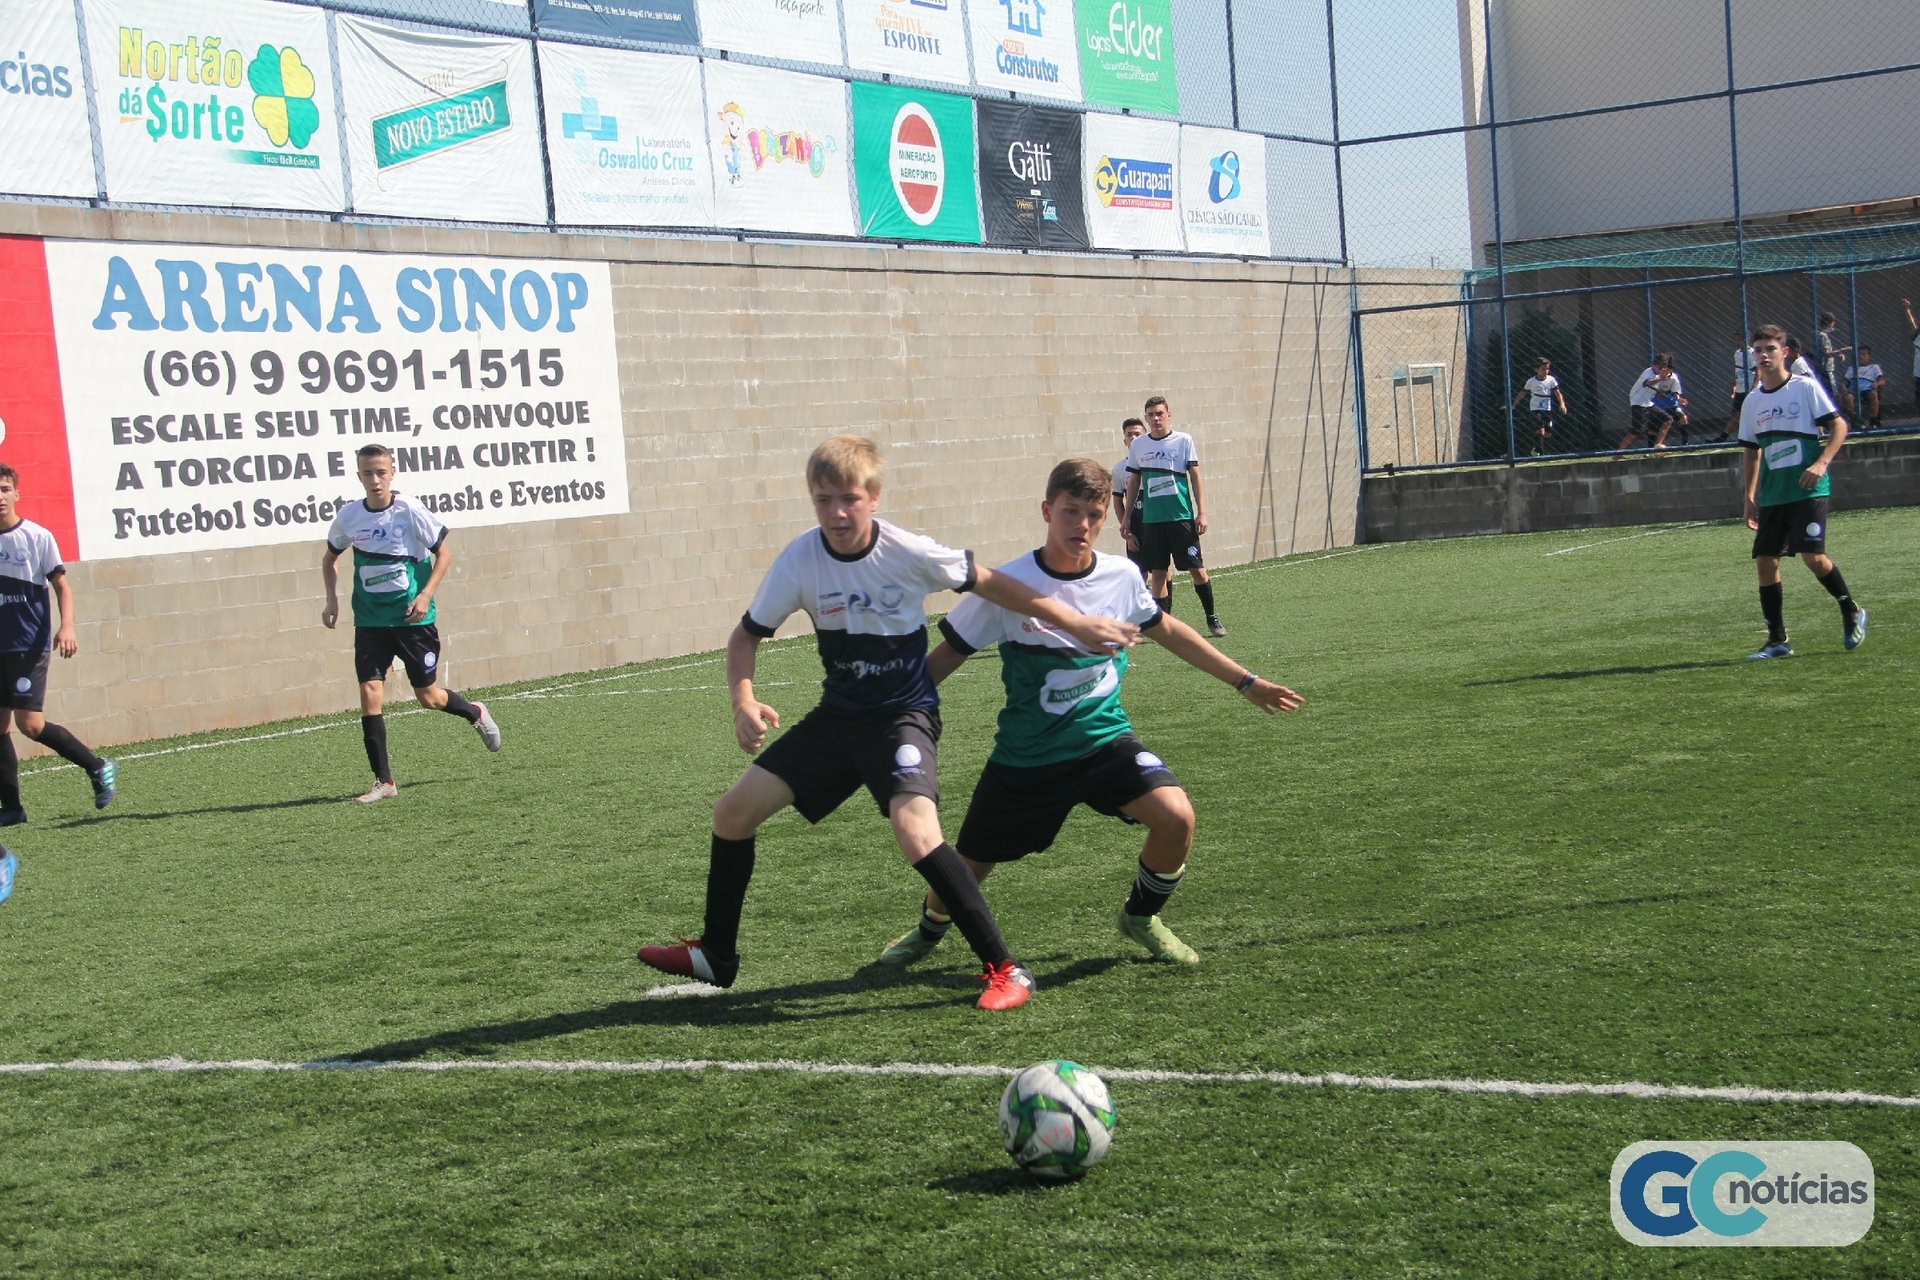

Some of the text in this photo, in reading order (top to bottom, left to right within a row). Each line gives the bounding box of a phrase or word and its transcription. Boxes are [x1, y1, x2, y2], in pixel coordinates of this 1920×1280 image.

[880, 4, 898, 19] Para
[883, 29, 942, 56] ESPORTE
[1109, 2, 1163, 61] Elder
[118, 26, 243, 88] Nortão
[996, 44, 1059, 83] Construtor
[118, 87, 142, 115] dá
[386, 96, 495, 156] NOVO ESTADO
[642, 137, 691, 149] Laboratório
[263, 154, 279, 163] Ficou
[598, 136, 694, 171] Oswaldo Cruz
[899, 149, 936, 164] MINERAÇÃO
[900, 167, 938, 182] AEROPORTO
[1117, 162, 1172, 198] Guarapari
[1217, 208, 1234, 226] SÃO
[92, 256, 588, 333] ARENA SINOP
[144, 348, 564, 396] (66) 9 9691-1515
[111, 400, 590, 445] ESCALE SEU TIME, CONVOQUE
[115, 437, 596, 491] A TORCIDA E NHA CURTIR !
[112, 500, 246, 539] Futebol
[253, 495, 355, 528] Societ
[490, 486, 503, 508] e
[508, 479, 606, 507] Eventos
[1053, 687, 1077, 701] NOVO
